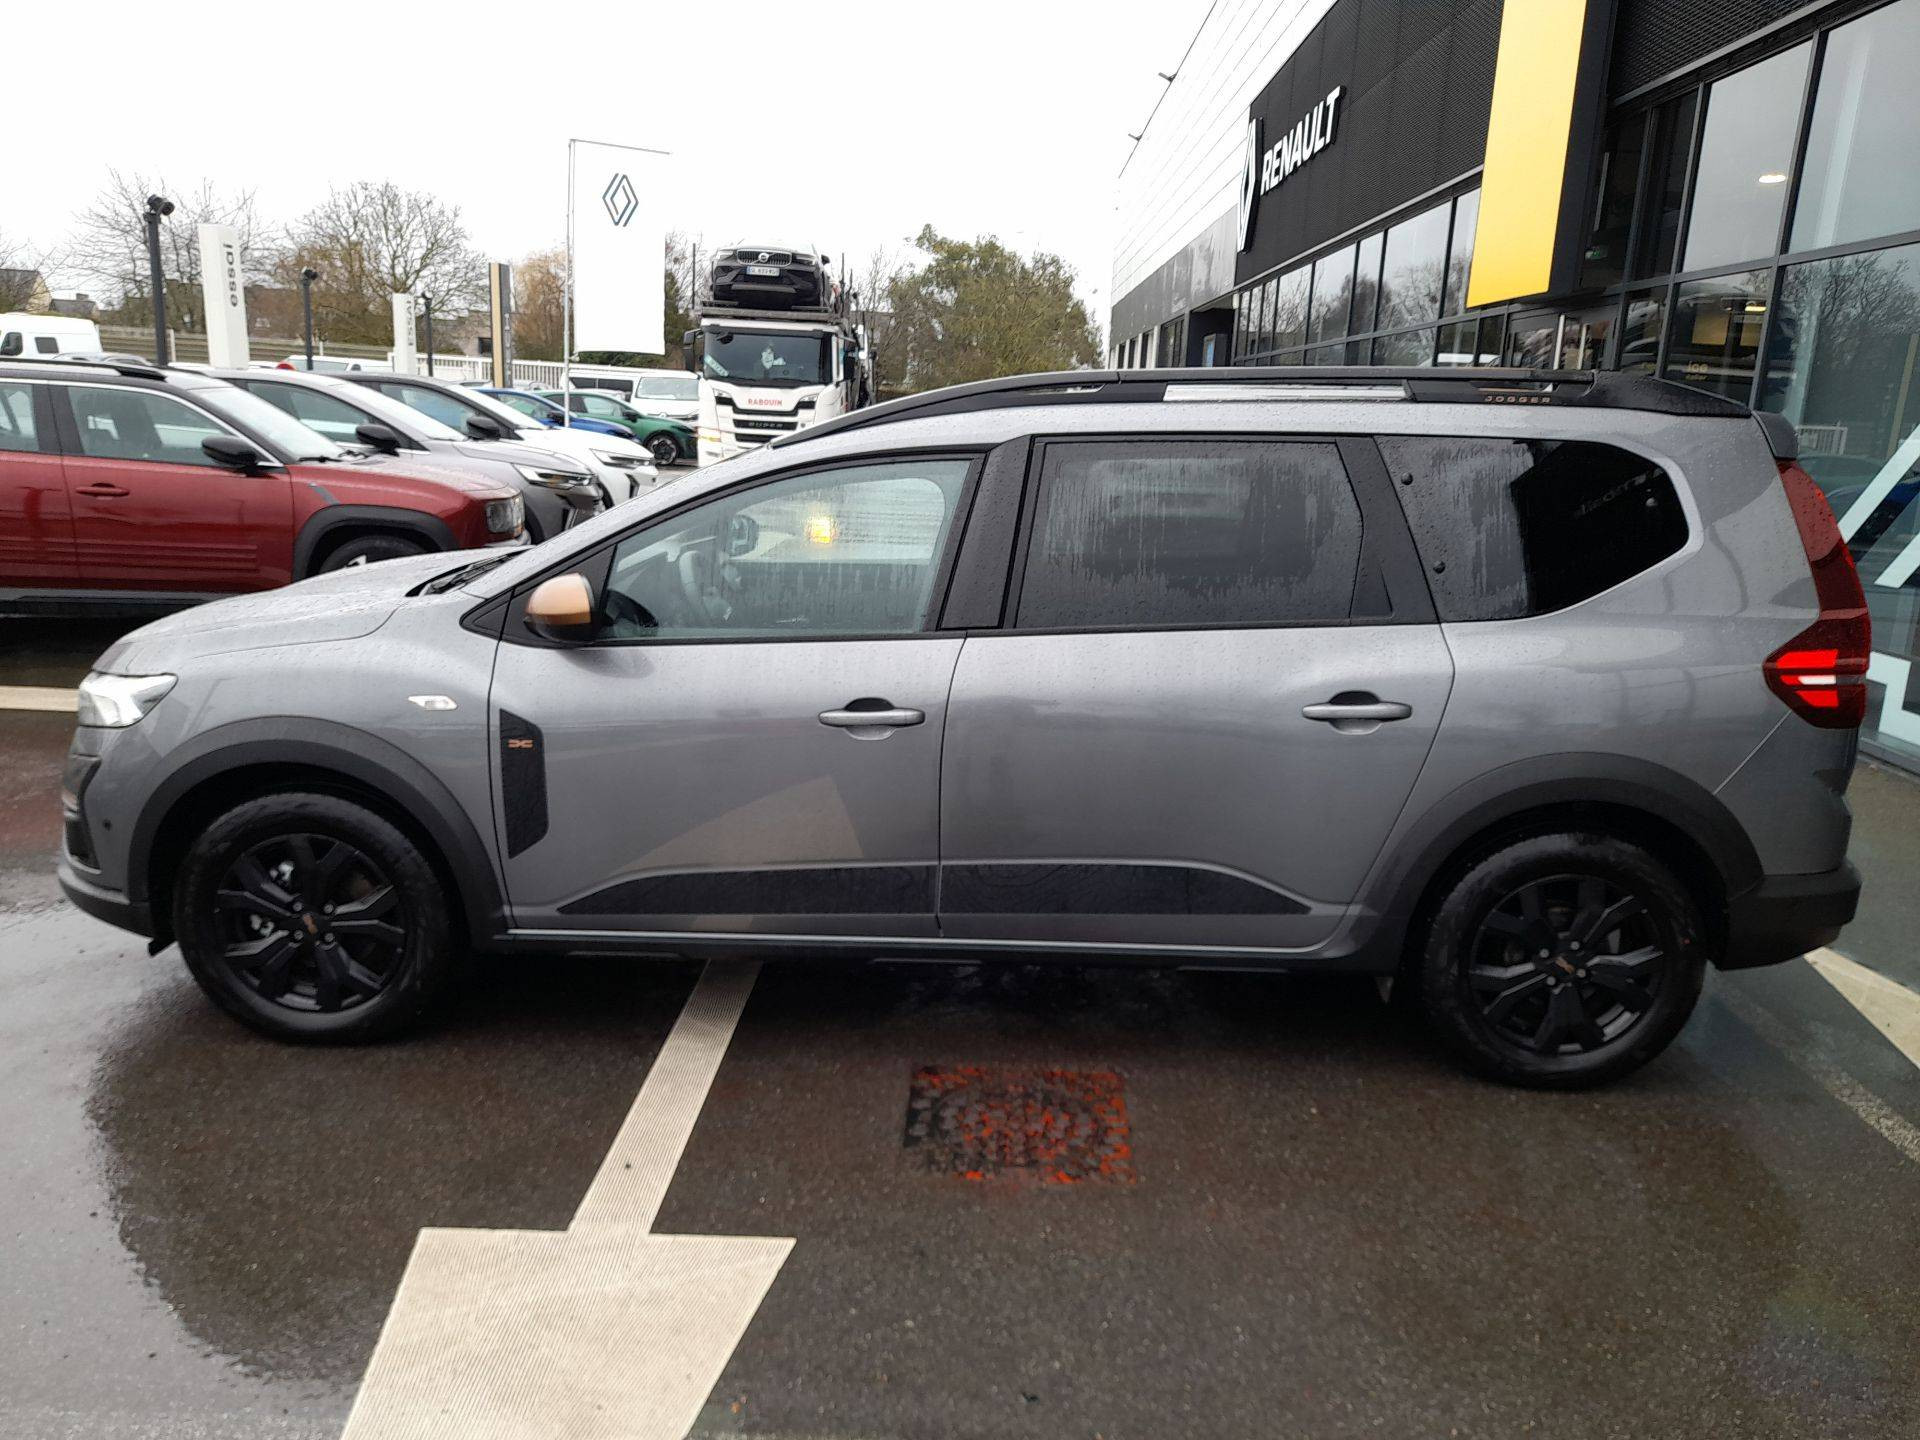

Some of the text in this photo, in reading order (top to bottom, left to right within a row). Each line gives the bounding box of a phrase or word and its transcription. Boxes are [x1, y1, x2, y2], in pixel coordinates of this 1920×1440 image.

[1260, 85, 1341, 196] RENAULT
[223, 243, 238, 308] essai
[1484, 395, 1551, 404] JOGGER
